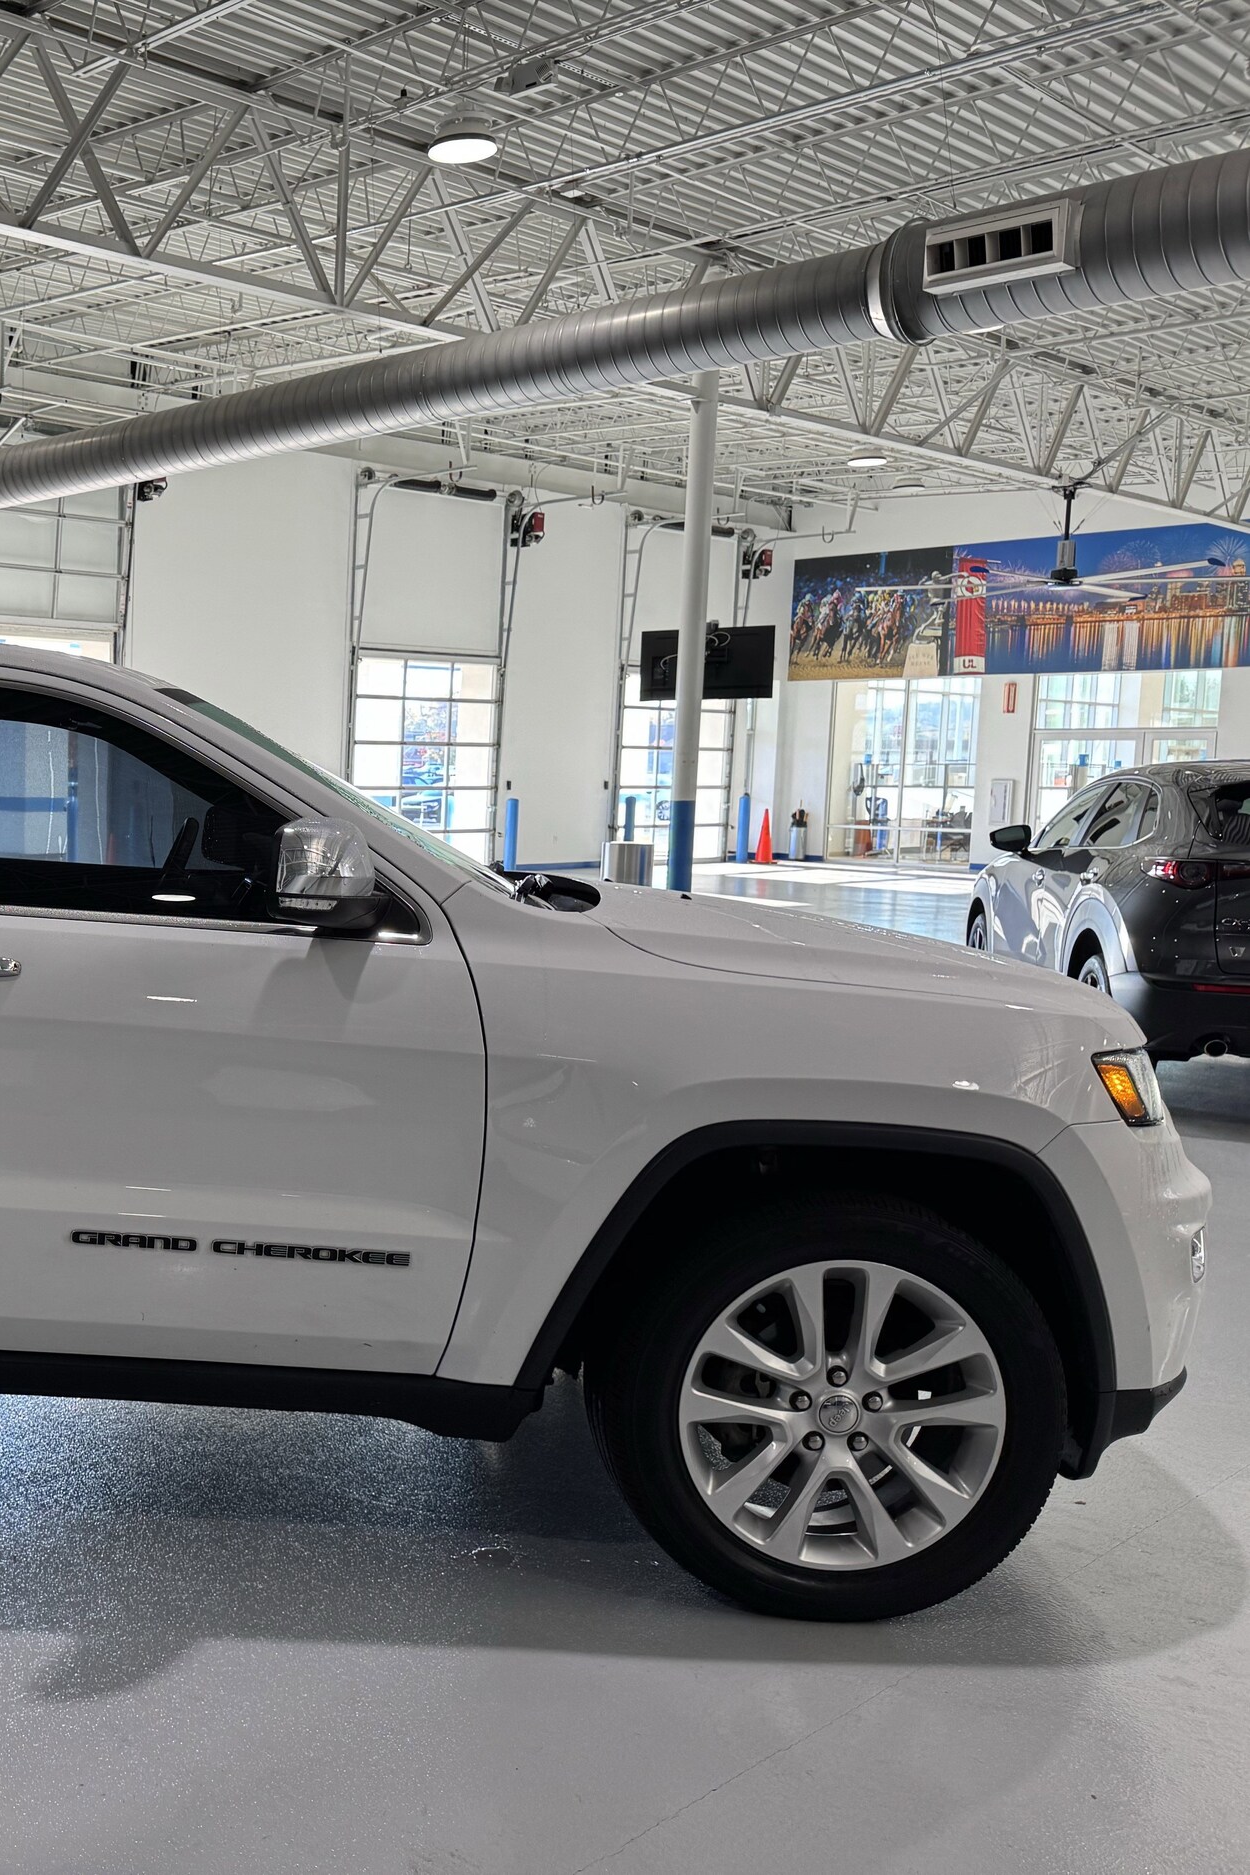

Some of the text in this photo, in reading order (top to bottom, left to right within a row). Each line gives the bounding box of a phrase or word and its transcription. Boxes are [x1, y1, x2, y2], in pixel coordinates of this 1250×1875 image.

[962, 658, 977, 669] UL
[70, 1229, 412, 1267] GRAND CHEROKEE
[829, 1404, 850, 1427] Jeep
